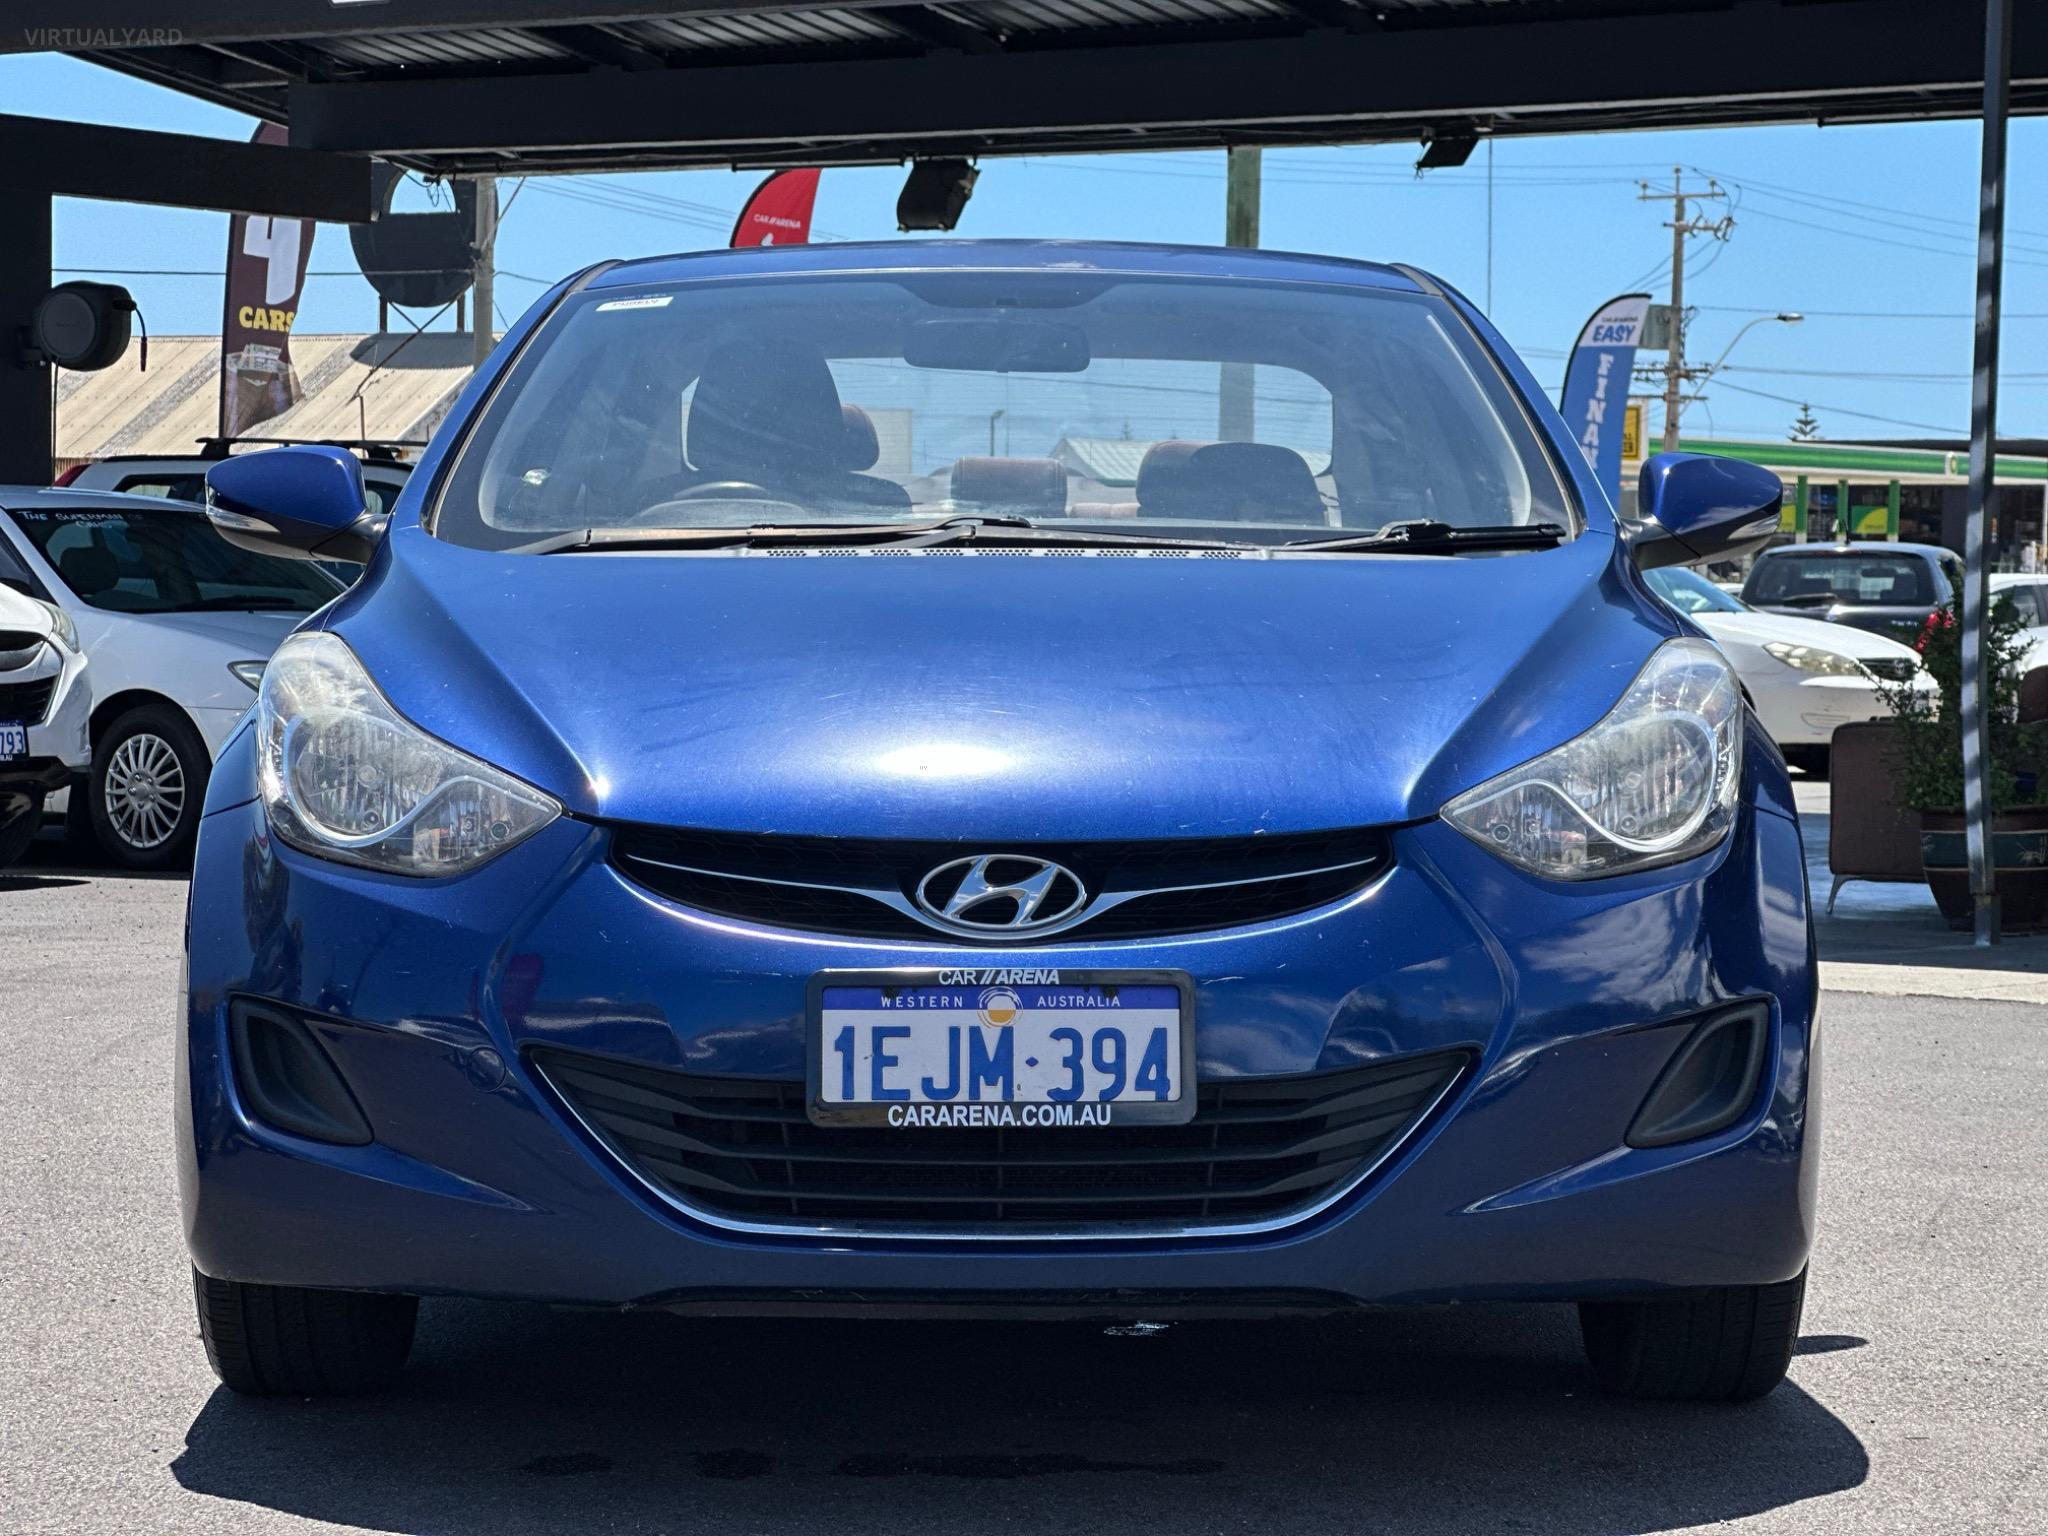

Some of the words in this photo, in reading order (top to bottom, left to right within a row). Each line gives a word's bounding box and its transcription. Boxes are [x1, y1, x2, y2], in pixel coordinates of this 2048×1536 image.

[1592, 324, 1636, 343] EASY
[17, 511, 48, 521] THE
[881, 996, 963, 1008] WESTERN
[1037, 995, 1121, 1007] AUSTRALIA
[887, 1104, 1112, 1127] CARARENA.COM.AU
